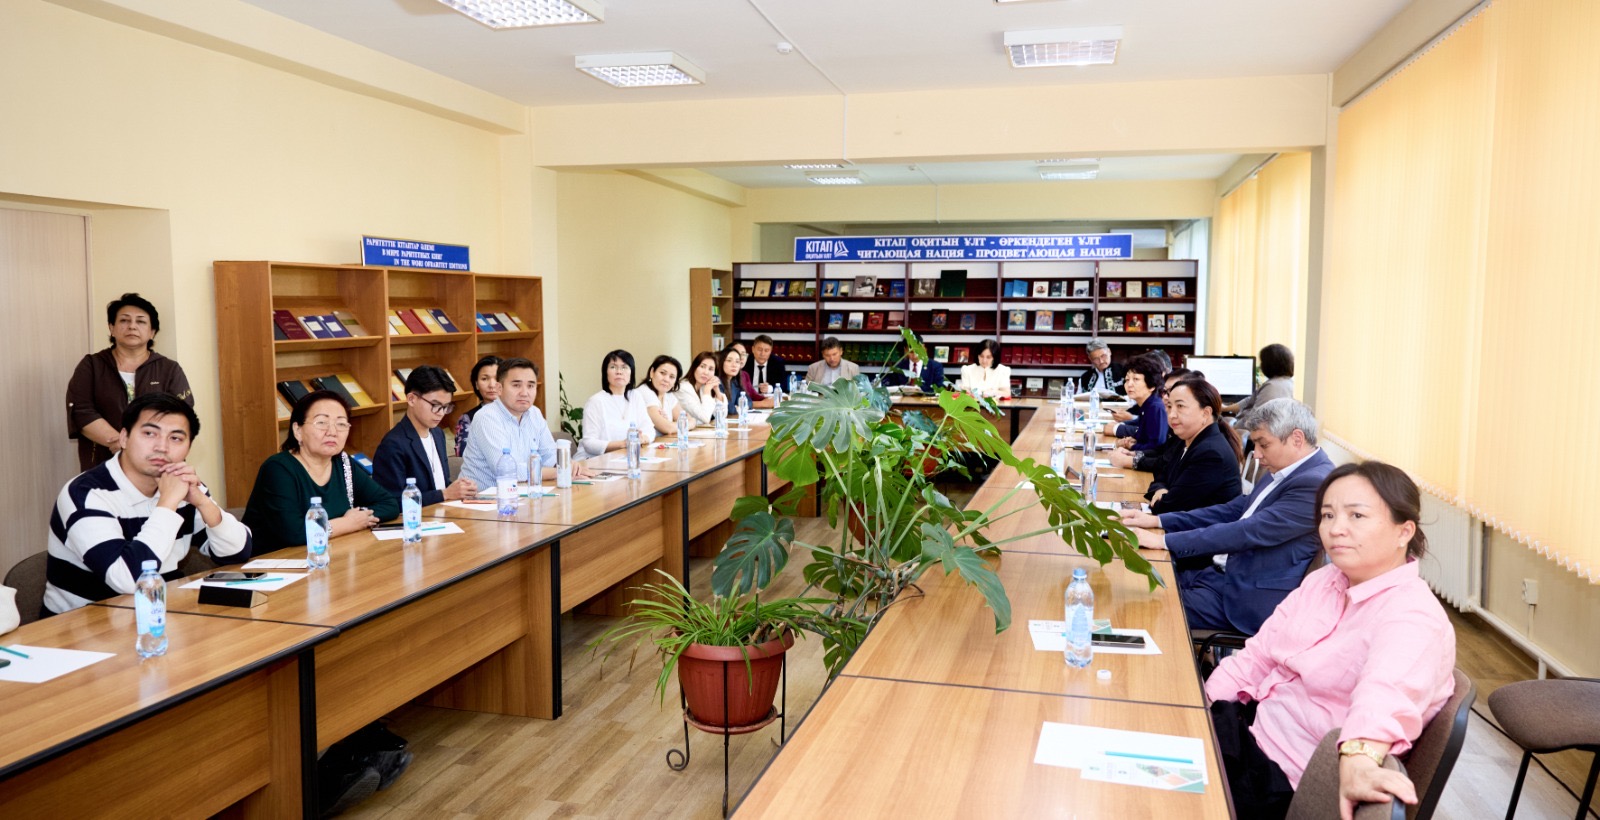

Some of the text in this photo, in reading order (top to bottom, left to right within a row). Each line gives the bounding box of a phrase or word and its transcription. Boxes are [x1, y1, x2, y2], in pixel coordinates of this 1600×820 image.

[805, 240, 833, 252] КІТАП
[874, 238, 906, 247] КІТАП
[911, 238, 959, 248] ОҚИТЫН
[964, 238, 986, 246] ҰЛТ
[998, 237, 1073, 247] ӨРКЕНДЕГЕН
[1078, 236, 1102, 246] ҰЛТ
[857, 249, 921, 260] ЧИТАЮЩАЯ
[925, 249, 964, 260] НАЦИЯ
[976, 248, 1074, 259] ПРОЦВЕТАЮЩАЯ
[1080, 248, 1121, 258] НАЦИЯ
